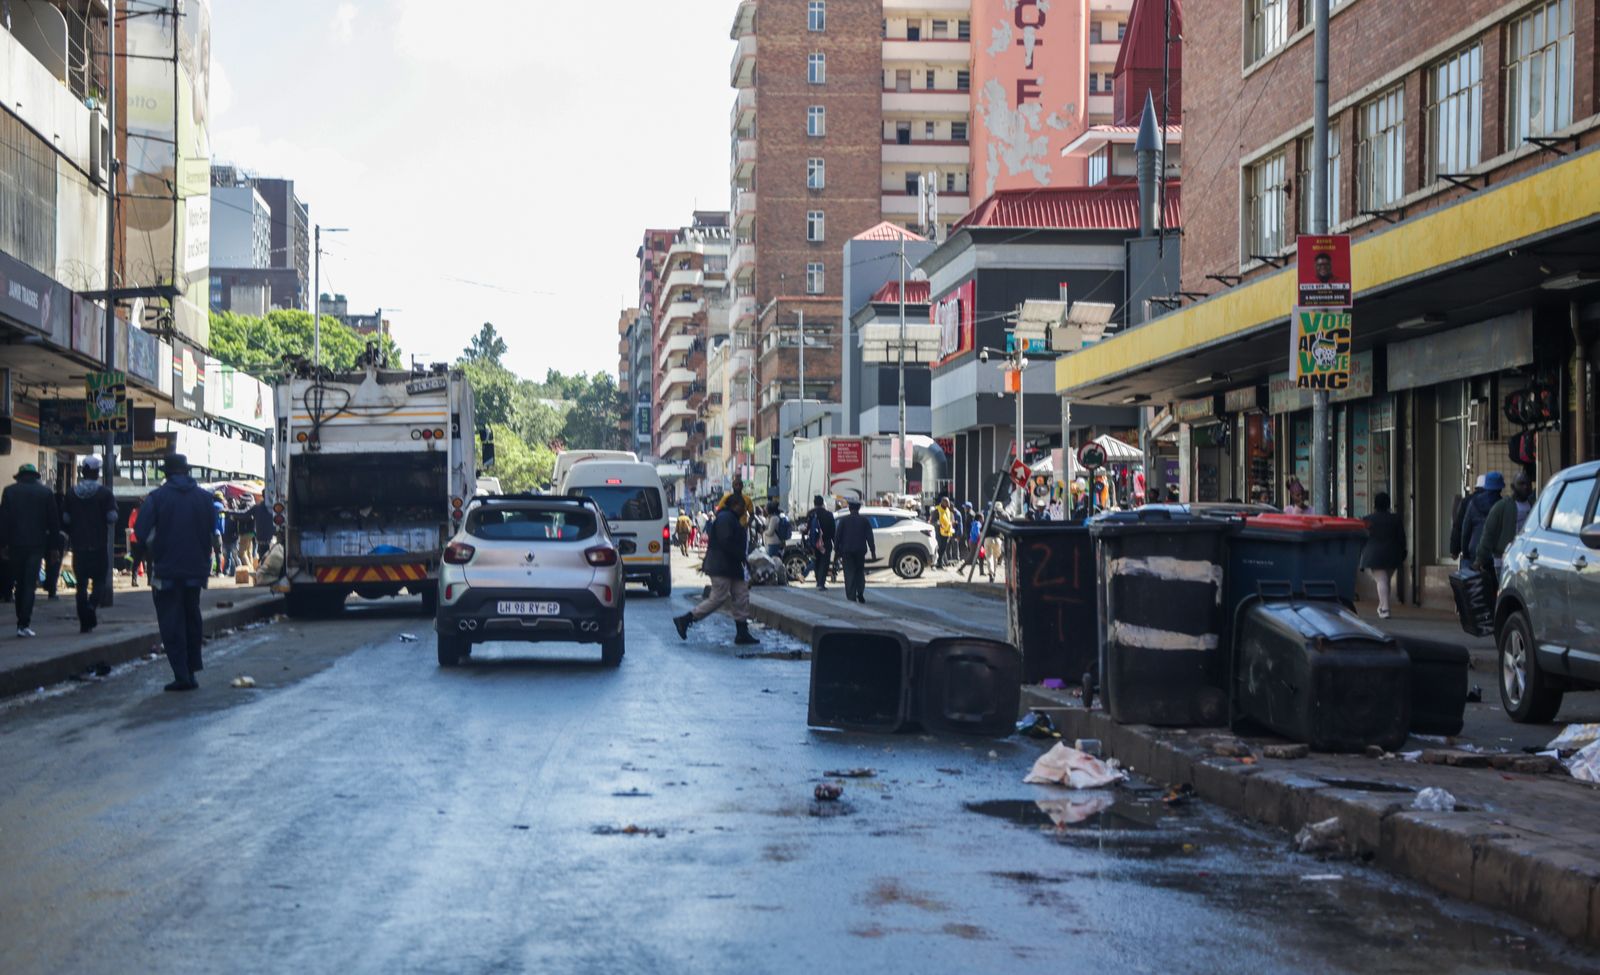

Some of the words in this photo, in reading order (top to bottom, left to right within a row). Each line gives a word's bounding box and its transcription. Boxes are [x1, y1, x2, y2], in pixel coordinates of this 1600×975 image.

[1300, 312, 1350, 334] VOTE
[1297, 372, 1348, 389] ANC
[88, 418, 126, 431] ANC
[500, 602, 511, 613] LH
[515, 602, 525, 613] 98
[529, 602, 540, 613] RY
[547, 602, 558, 613] GP
